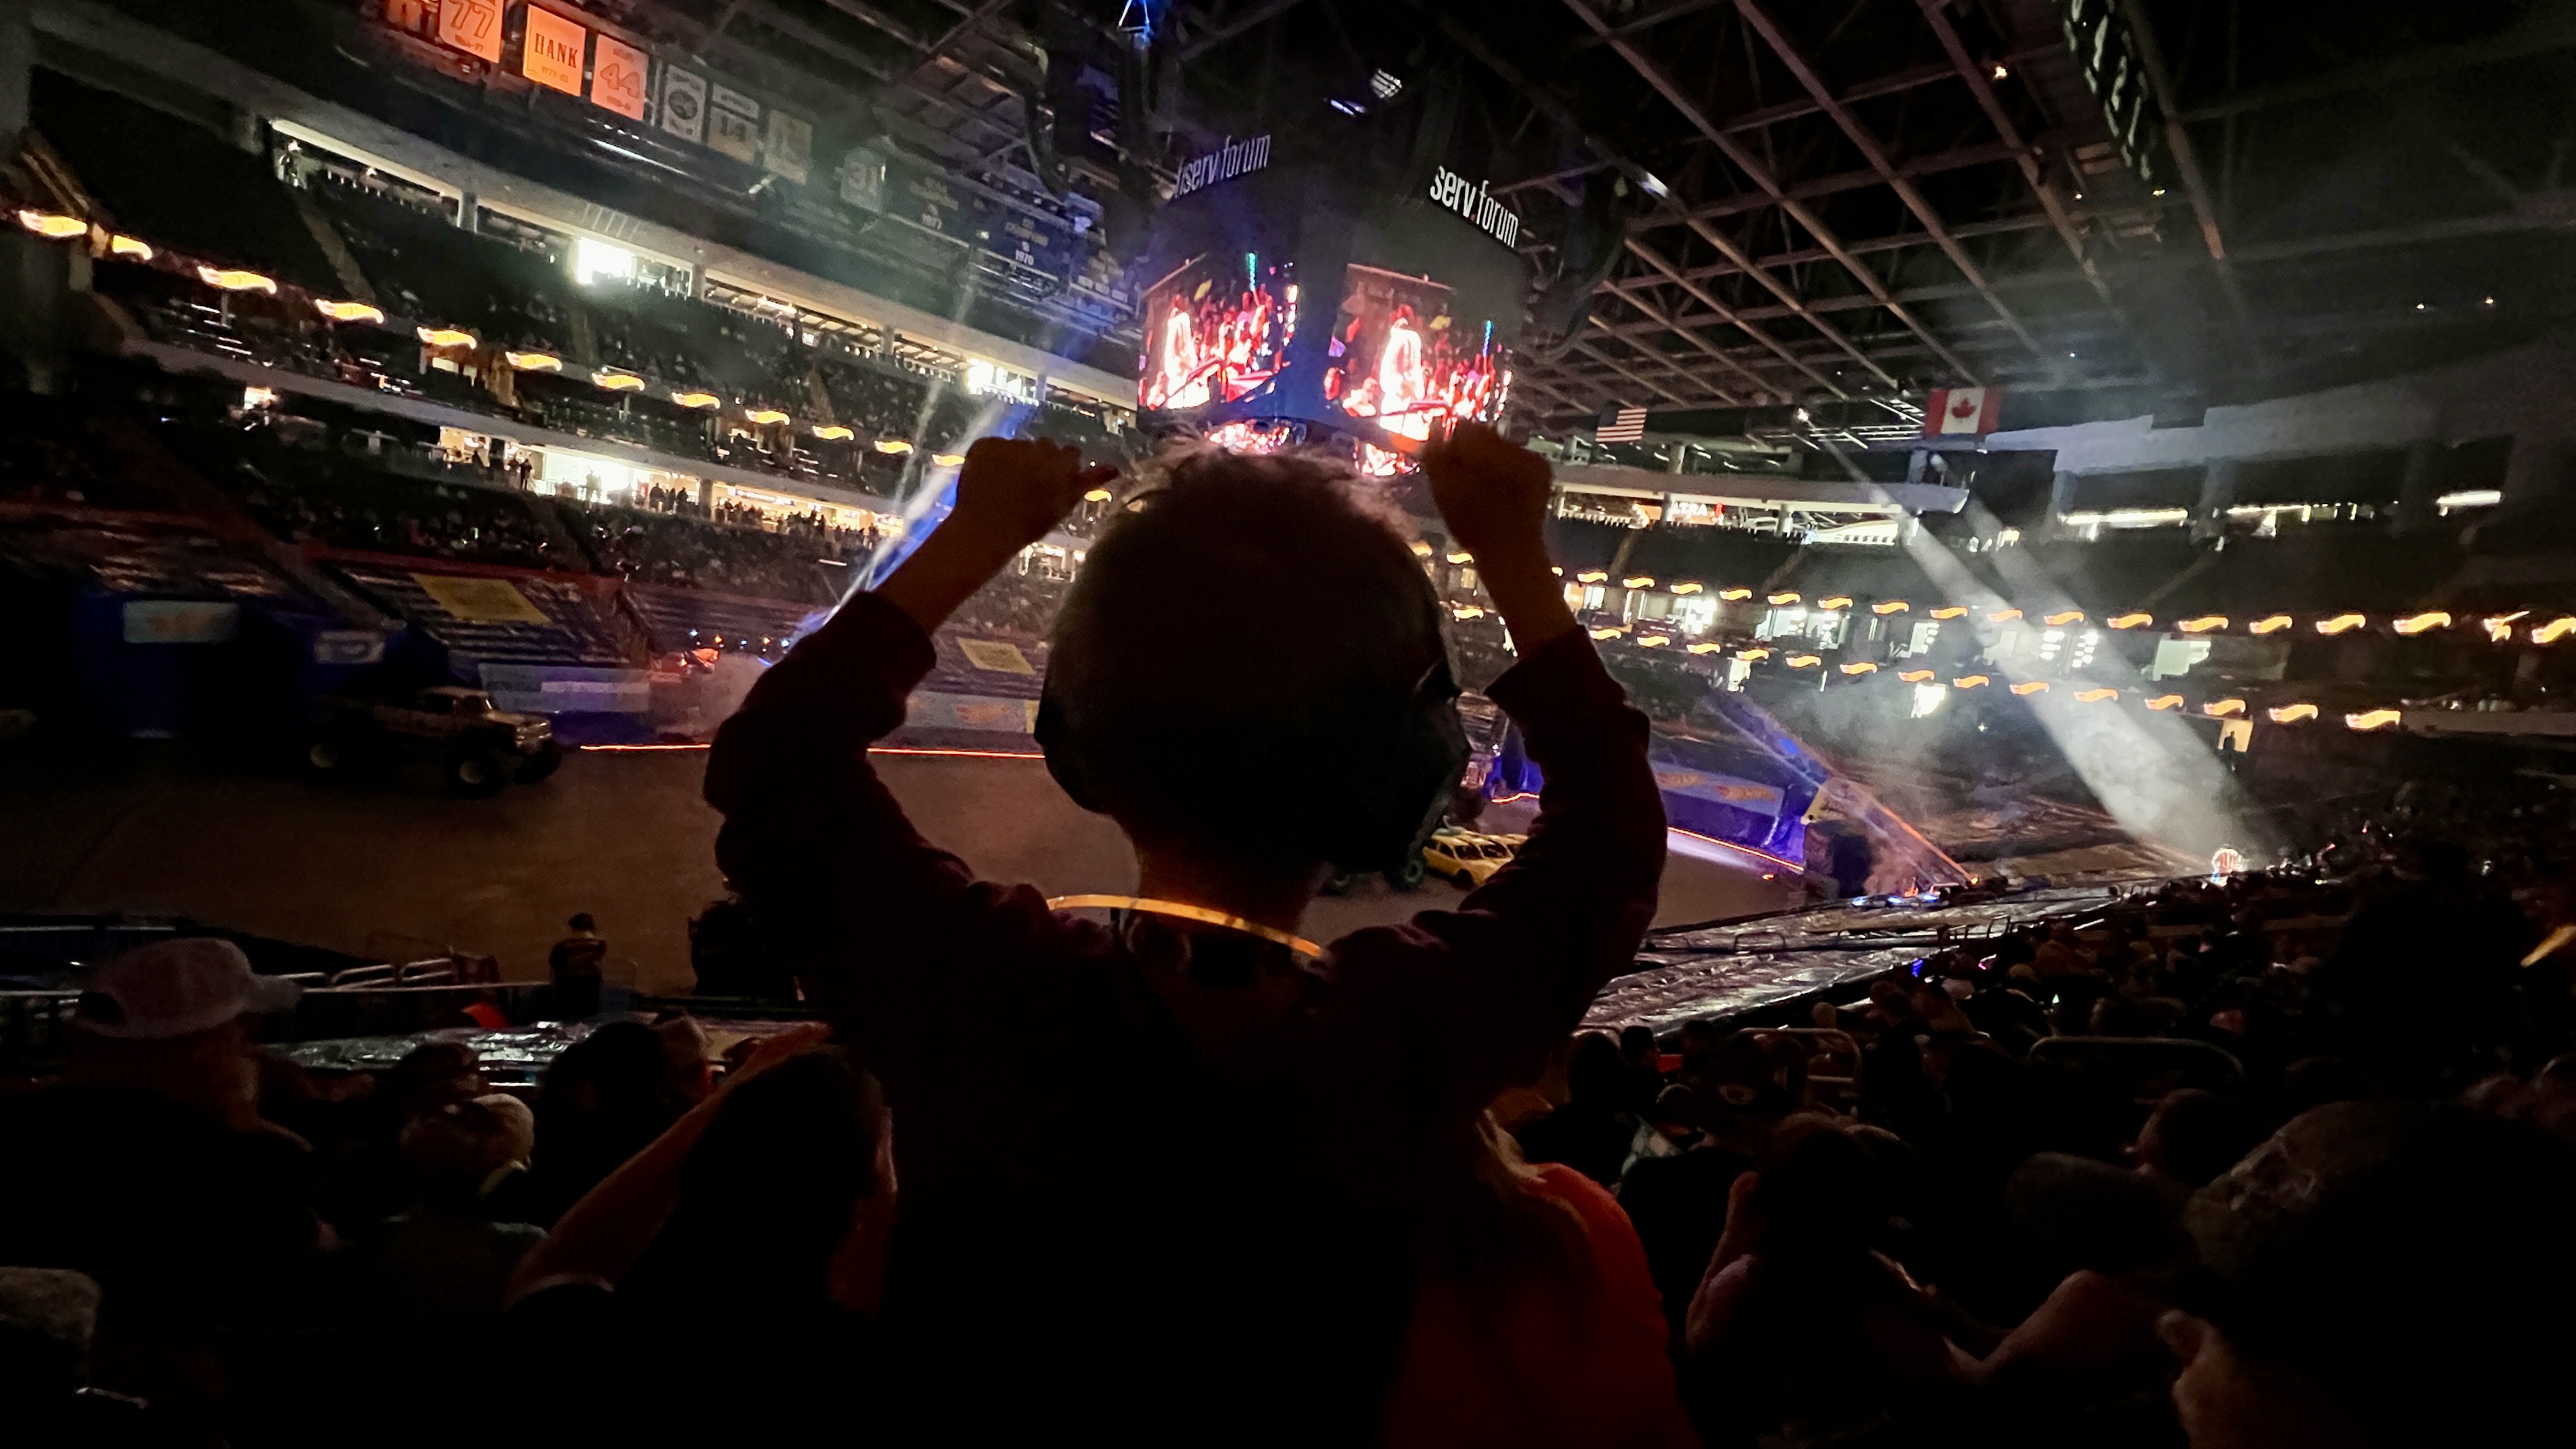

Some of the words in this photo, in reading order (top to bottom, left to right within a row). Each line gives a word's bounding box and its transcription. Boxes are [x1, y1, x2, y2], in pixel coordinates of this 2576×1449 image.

[448, 0, 496, 39] 77
[534, 33, 578, 68] HANK
[600, 63, 640, 99] 44
[1221, 134, 1271, 180] forum
[1476, 180, 1519, 248] forum
[1015, 249, 1034, 266] 1970
